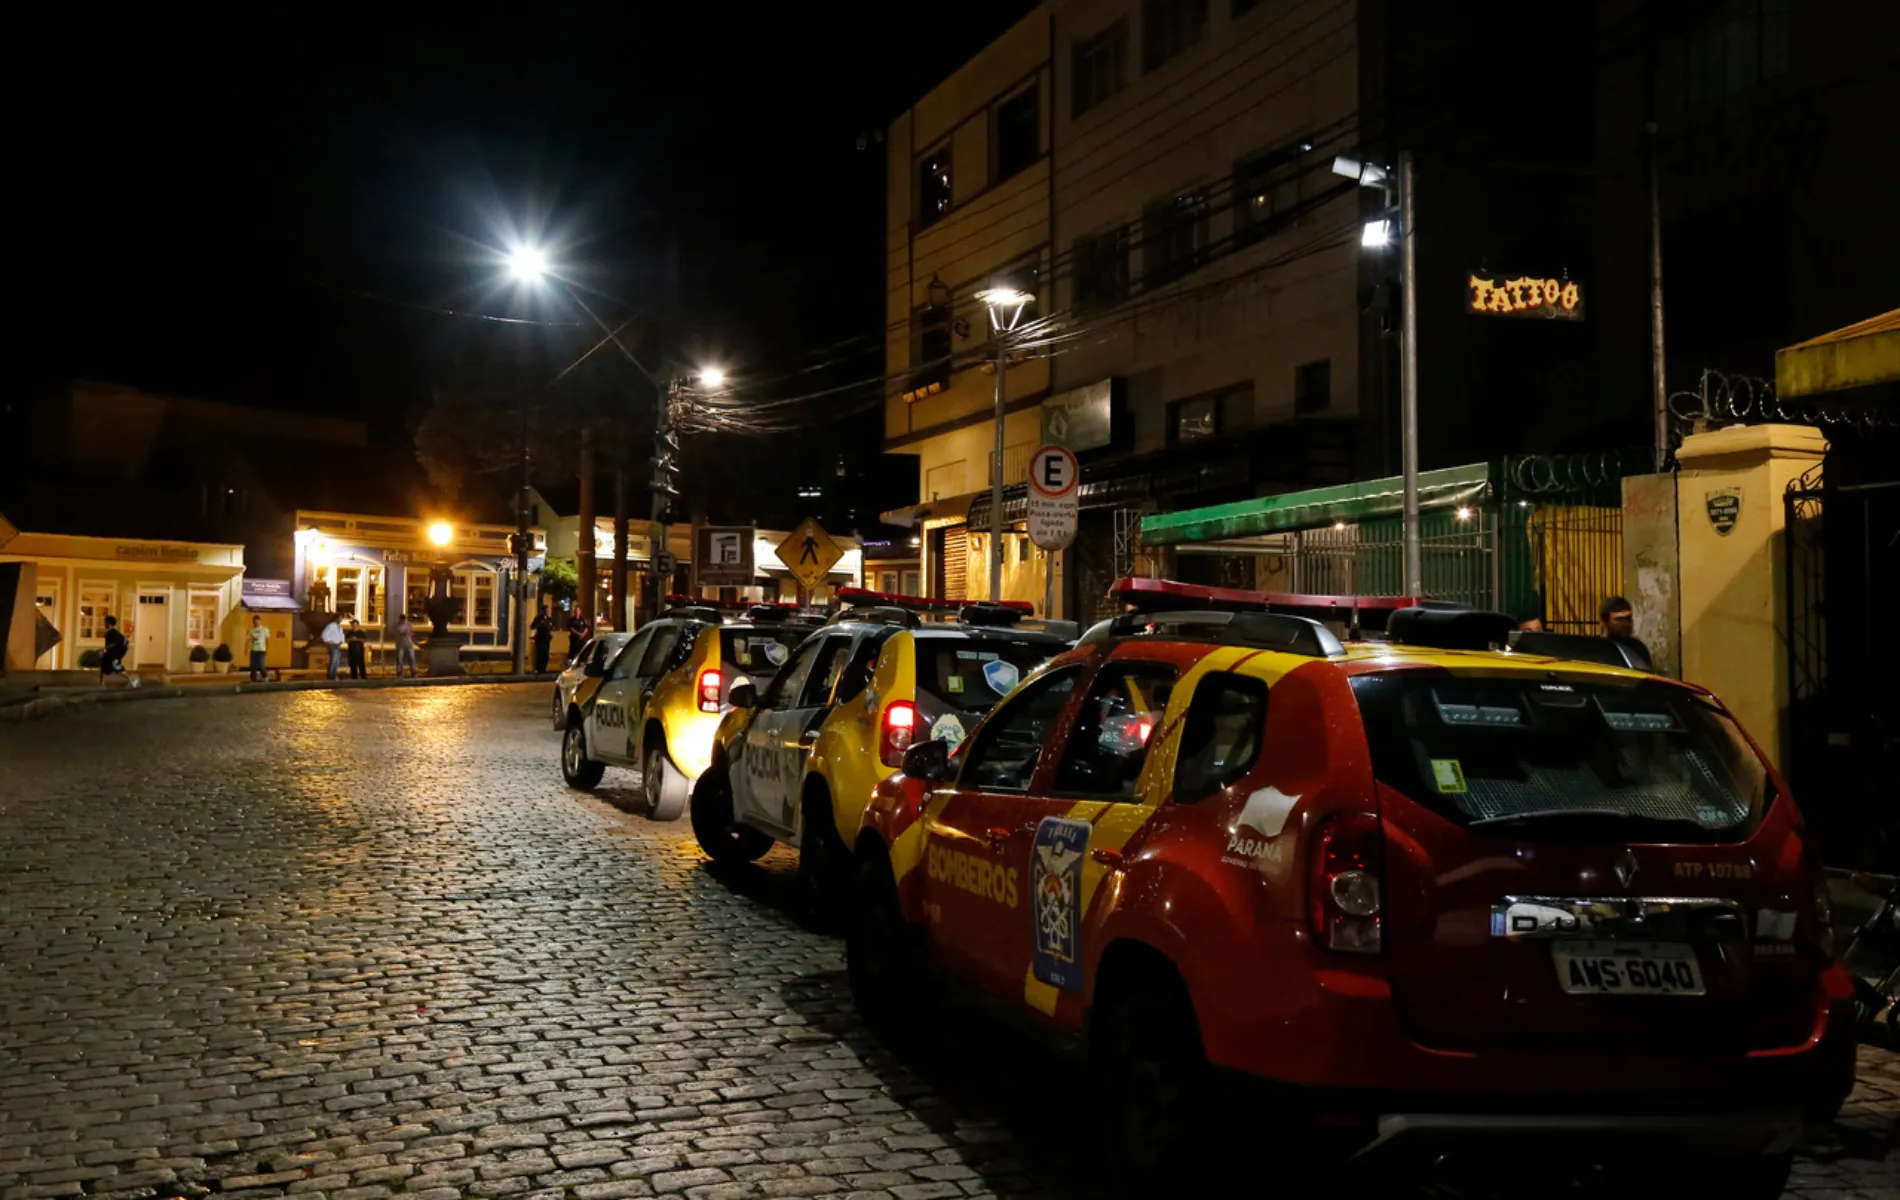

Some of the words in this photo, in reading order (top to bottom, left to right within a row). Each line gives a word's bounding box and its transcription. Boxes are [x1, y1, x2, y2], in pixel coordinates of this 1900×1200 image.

[1469, 275, 1580, 312] TATTOO
[1045, 455, 1063, 486] E
[927, 843, 1018, 909] BOMBEIROS
